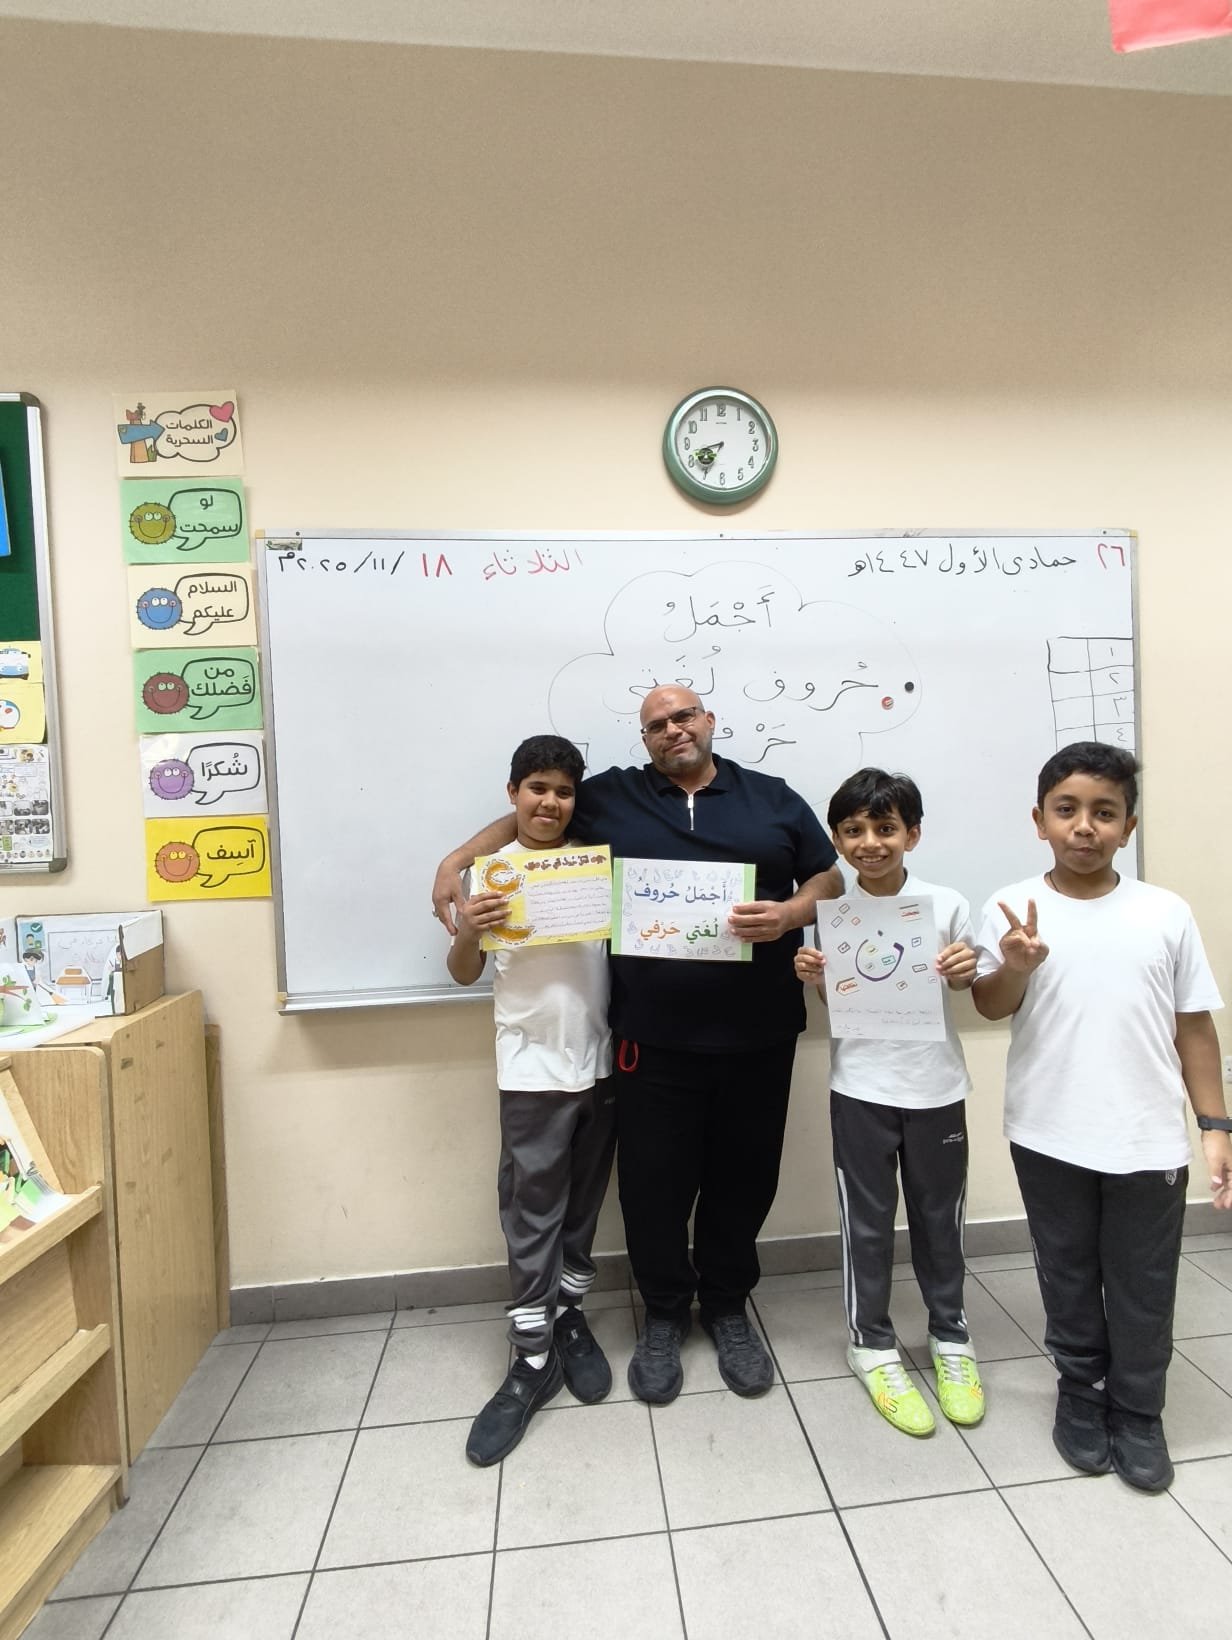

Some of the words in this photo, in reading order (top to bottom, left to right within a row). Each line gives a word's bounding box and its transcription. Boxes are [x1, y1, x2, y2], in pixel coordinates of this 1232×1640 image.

[700, 407, 708, 422] 11
[716, 403, 727, 417] 12
[736, 407, 742, 421] 1
[166, 419, 213, 432] الكلمات
[688, 420, 698, 434] 10
[747, 420, 756, 435] 2
[166, 434, 214, 448] السحرية
[684, 437, 691, 451] 9
[752, 438, 760, 452] 3
[688, 454, 695, 468] 8
[747, 455, 755, 469] 4
[737, 467, 744, 481] 5
[199, 495, 214, 510] لو
[179, 522, 239, 534] سمحت
[187, 581, 237, 597] السلام
[192, 607, 235, 623] عليكم
[204, 666, 235, 679] من
